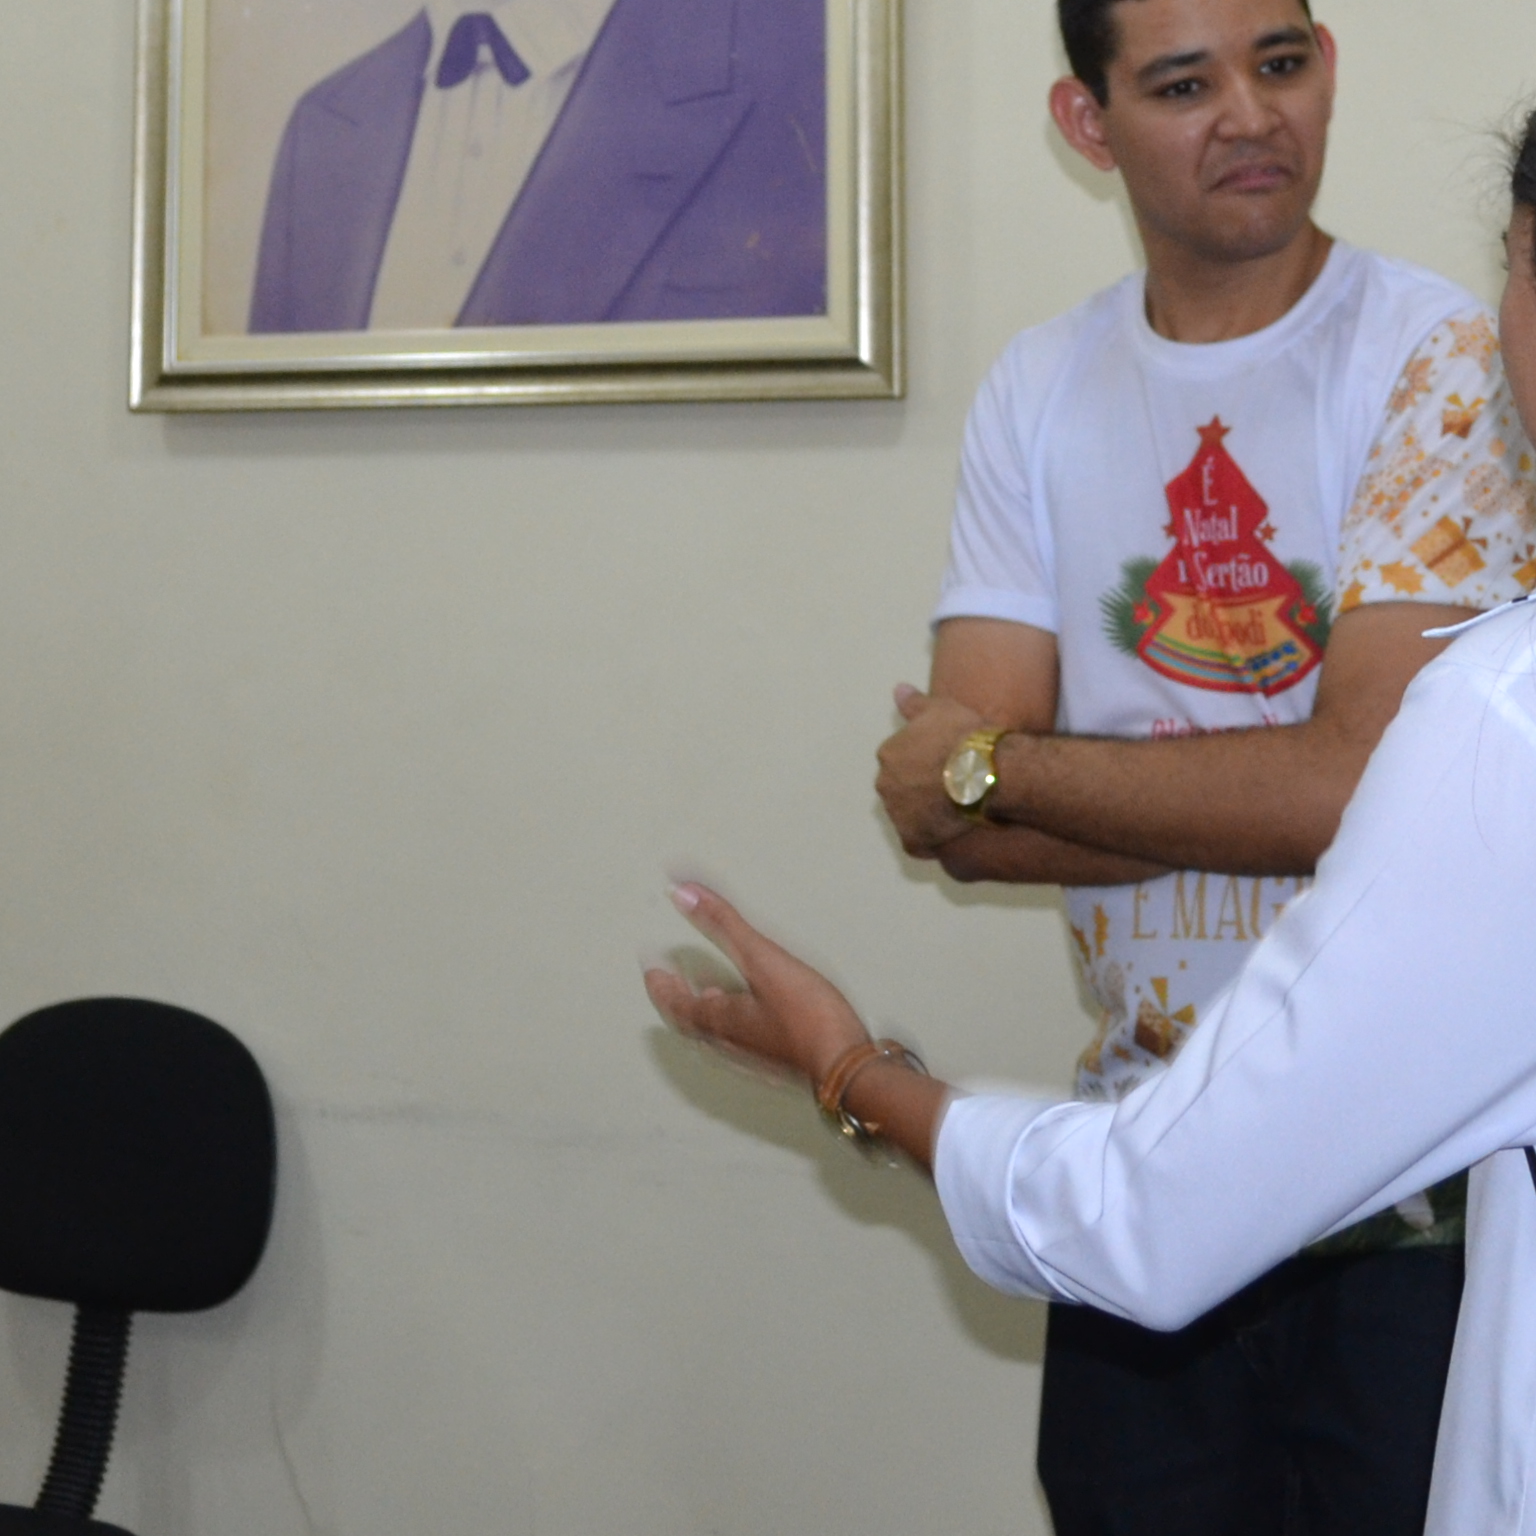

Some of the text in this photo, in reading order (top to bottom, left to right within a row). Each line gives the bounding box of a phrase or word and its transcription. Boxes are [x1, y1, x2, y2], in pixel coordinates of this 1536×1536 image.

[1202, 455, 1219, 506] É
[1183, 505, 1238, 548] Natal
[1193, 551, 1269, 593] Sertão
